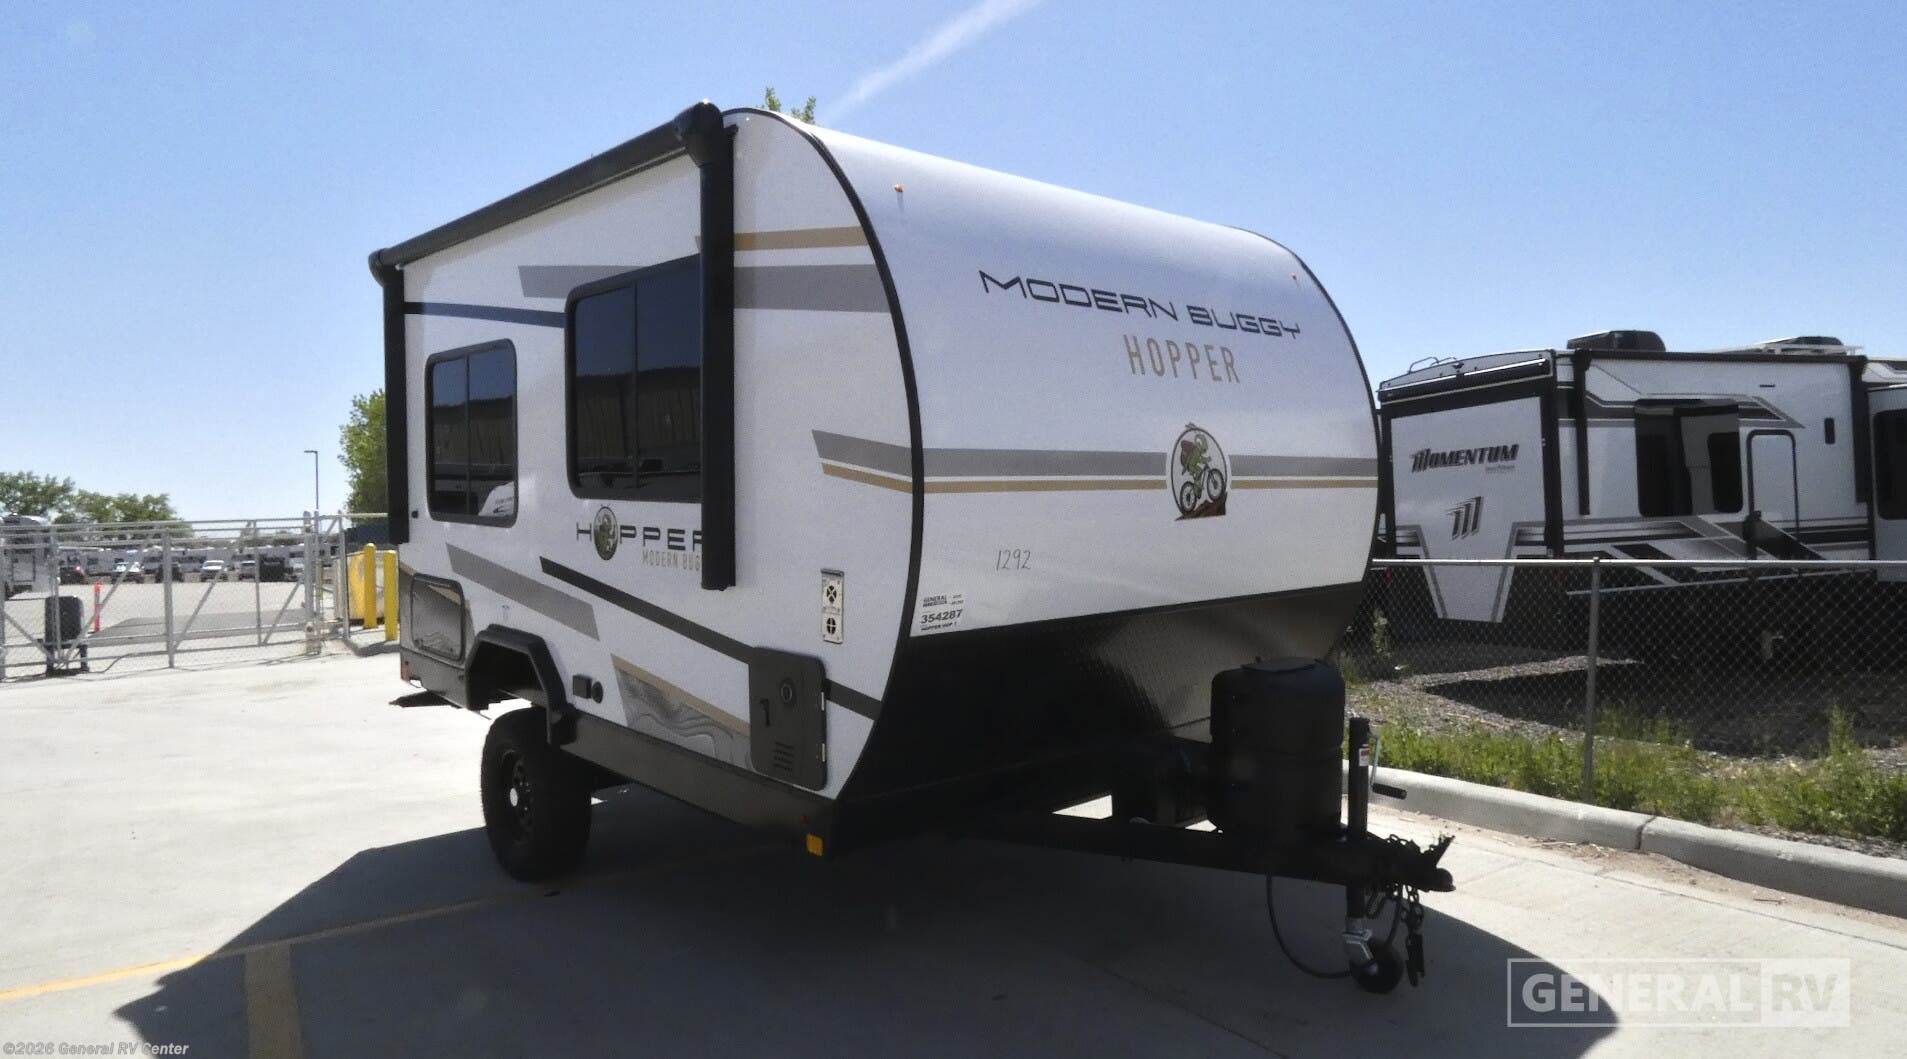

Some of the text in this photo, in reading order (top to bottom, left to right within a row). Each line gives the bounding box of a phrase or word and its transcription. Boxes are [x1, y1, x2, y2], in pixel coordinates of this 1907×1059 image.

[979, 270, 1301, 339] MODERN BUGGY
[1123, 334, 1240, 384] HOPPER
[1409, 443, 1520, 474] MOMENTUM
[642, 550, 702, 572] MODERN BUG
[996, 548, 1032, 571] 1292
[920, 609, 964, 624] 354287
